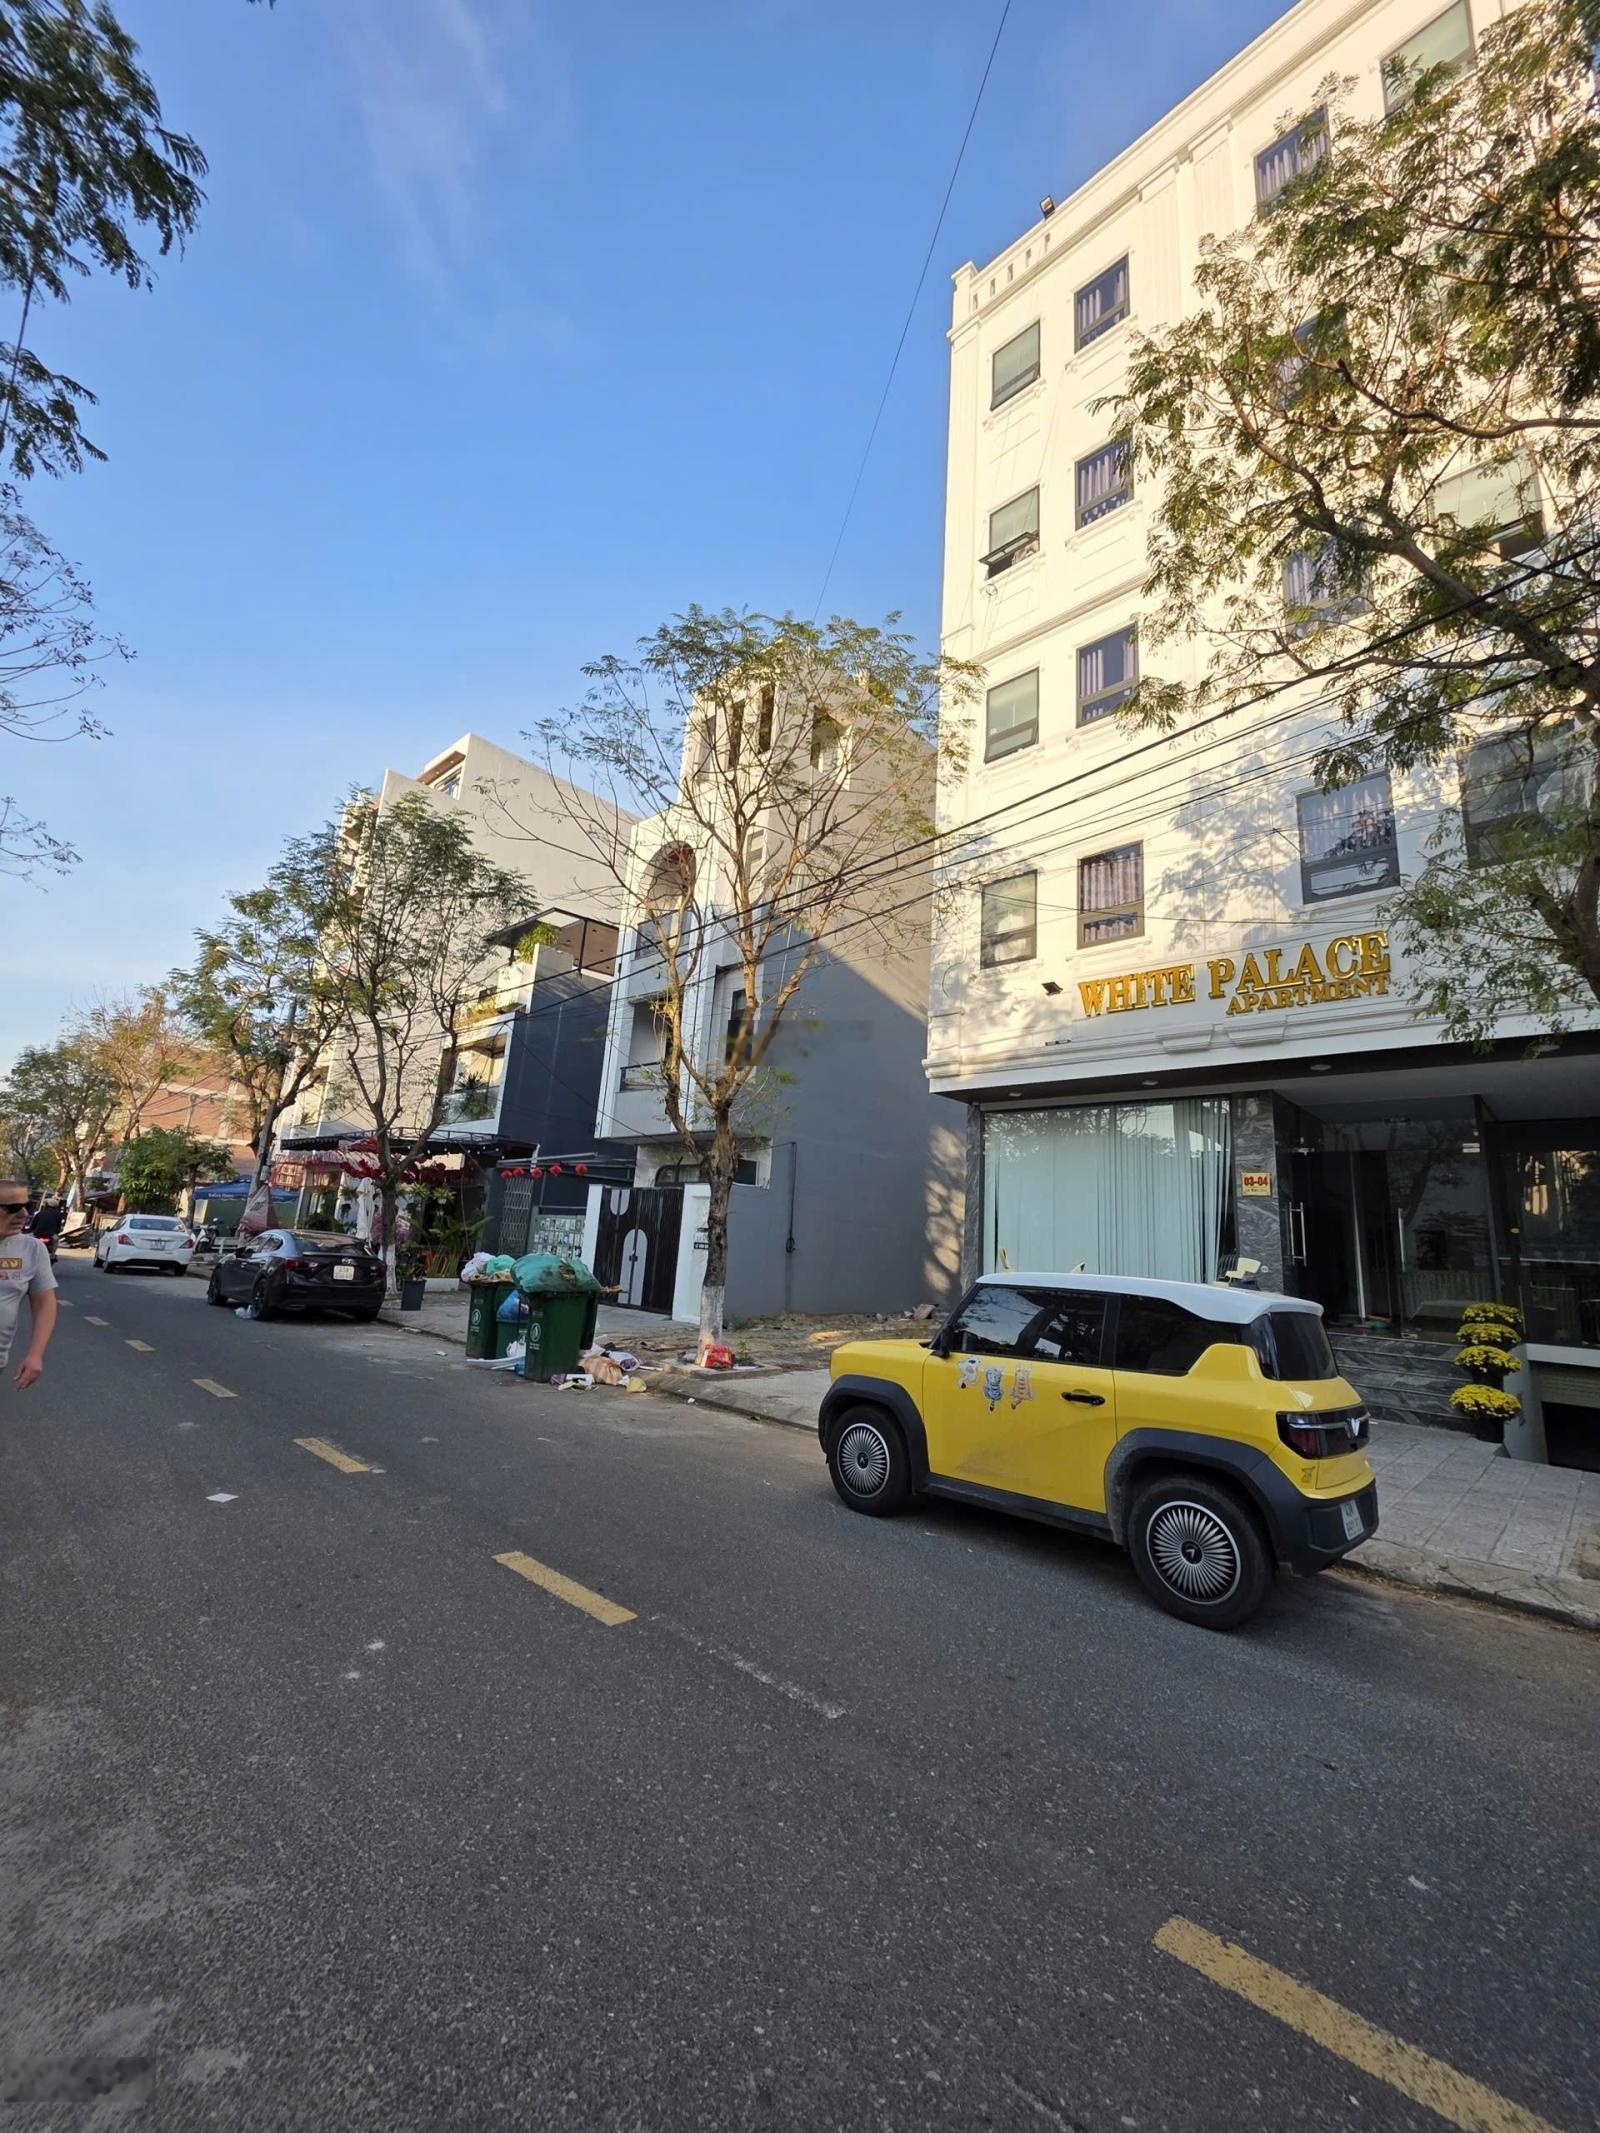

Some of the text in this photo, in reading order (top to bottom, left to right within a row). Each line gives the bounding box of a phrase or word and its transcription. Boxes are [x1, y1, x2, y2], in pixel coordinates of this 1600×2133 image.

[1079, 930, 1391, 1016] WHITE PALACE
[1226, 975, 1390, 1015] APARTMENT
